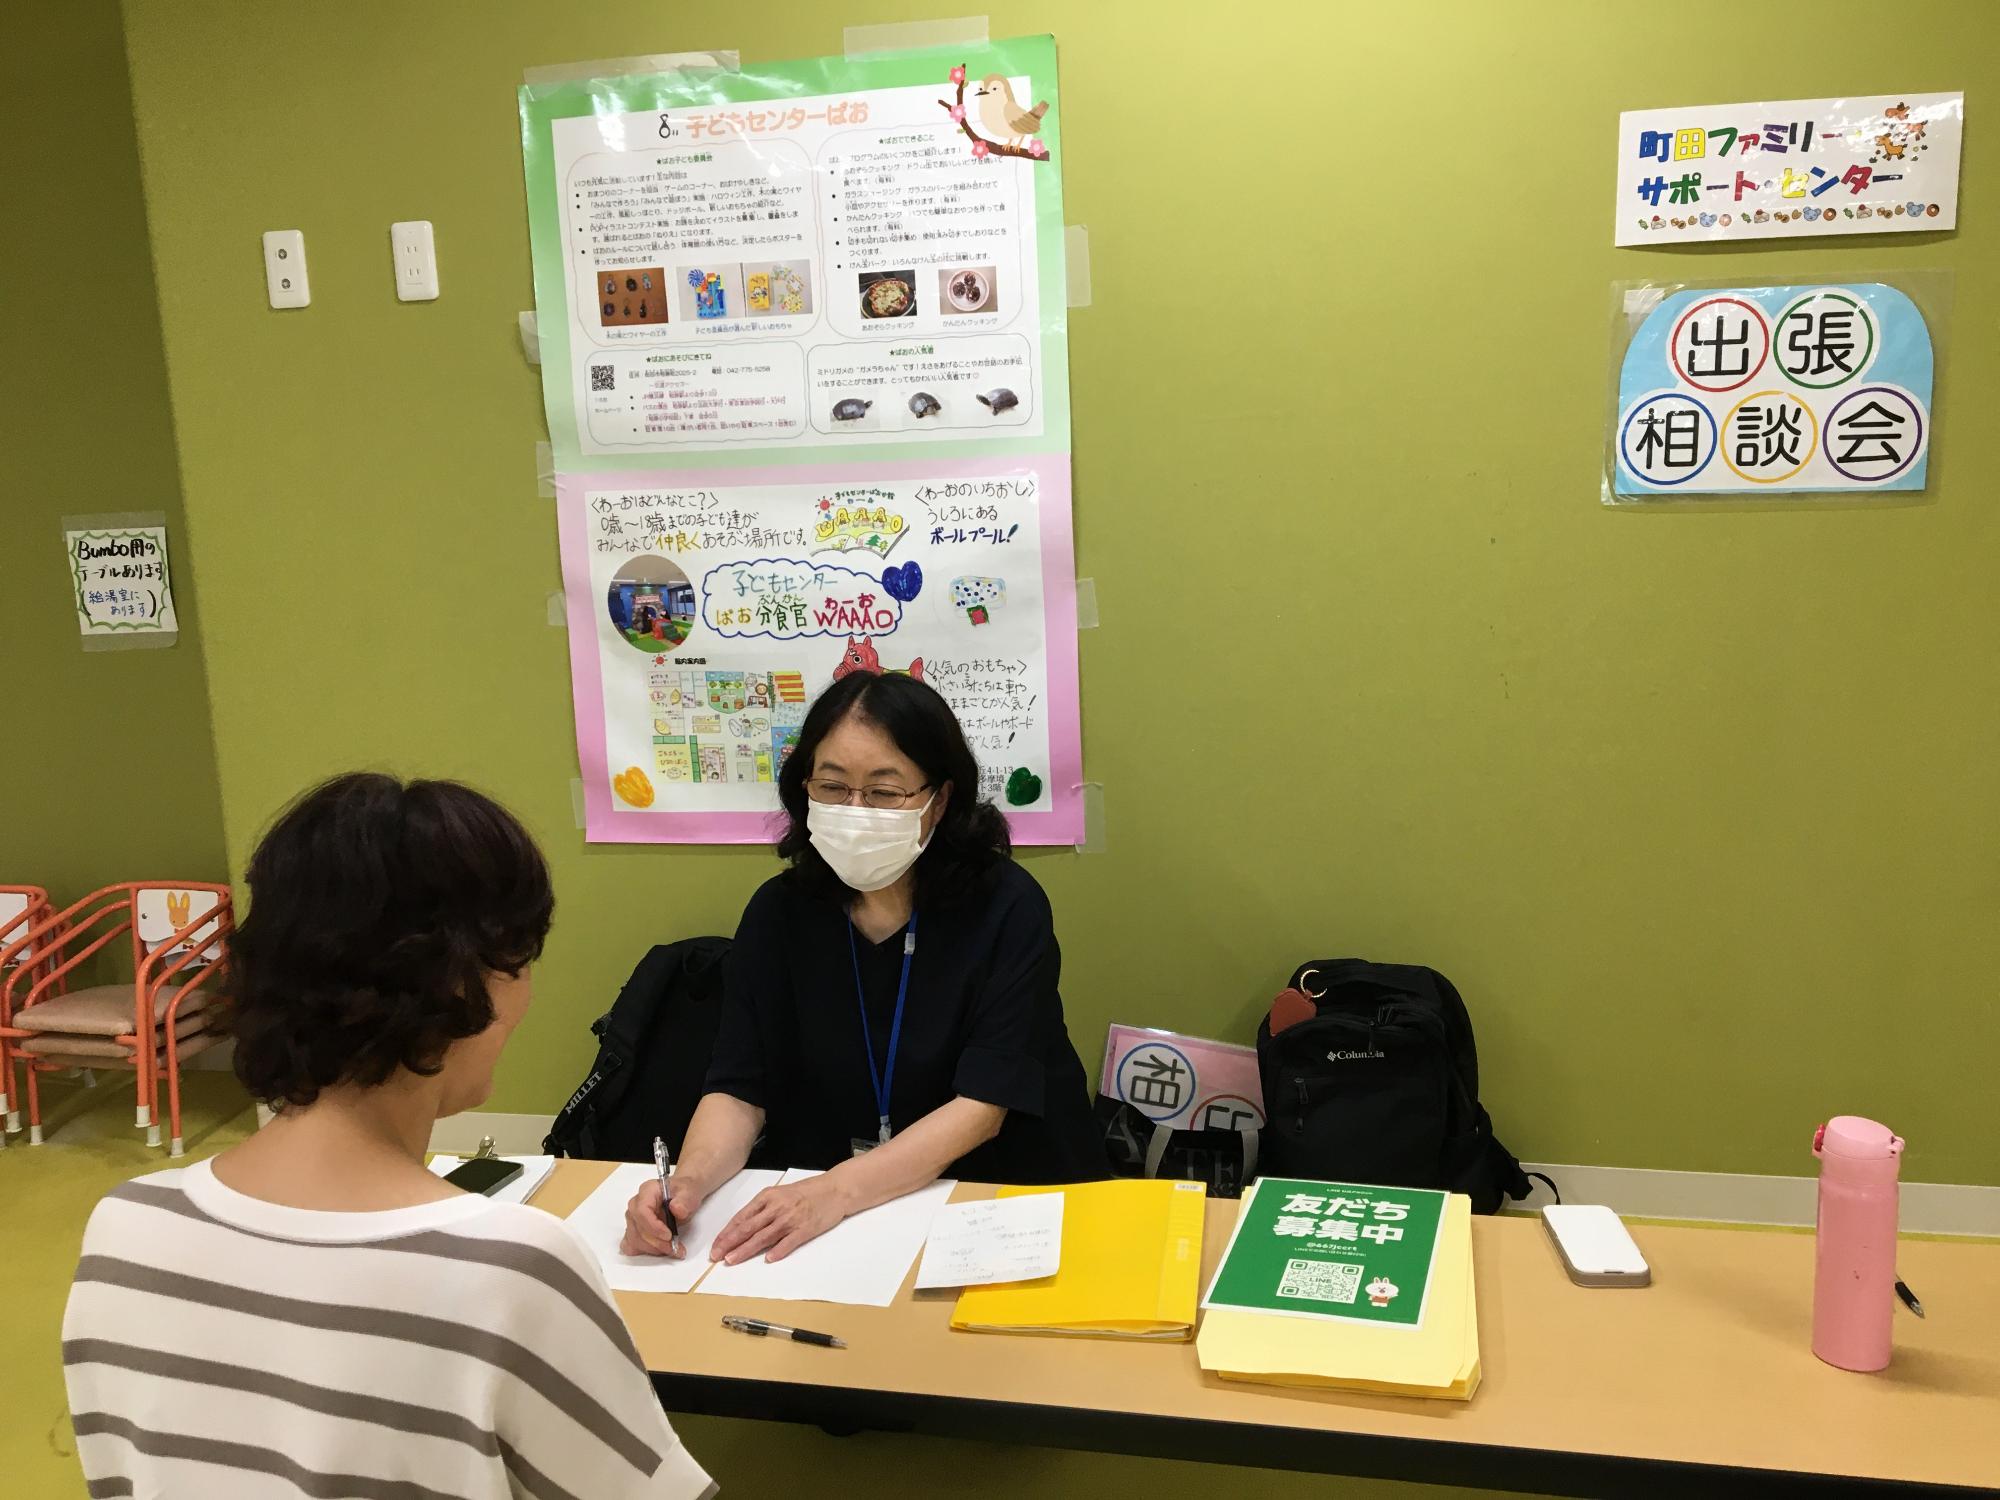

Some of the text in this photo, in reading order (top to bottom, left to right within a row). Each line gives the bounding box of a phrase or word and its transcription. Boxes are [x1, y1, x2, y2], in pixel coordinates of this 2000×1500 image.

[686, 101, 868, 138] 子どもセンターぱお
[1639, 121, 1843, 162] 町田ファミリー
[1688, 311, 1855, 376] 出張
[1636, 401, 1906, 470] 相談会
[927, 505, 998, 526] うしろにある
[78, 539, 155, 560] Bumbo用の
[597, 528, 808, 553] みんなで仲良くあそぶ場所です。
[79, 561, 163, 582] テーブルあります
[732, 569, 839, 597] 子どもセンター
[814, 607, 894, 631] WAAAO
[565, 1071, 602, 1115] MILLET
[1281, 1193, 1411, 1221] 友だち
[1273, 1215, 1404, 1245] 募集中
